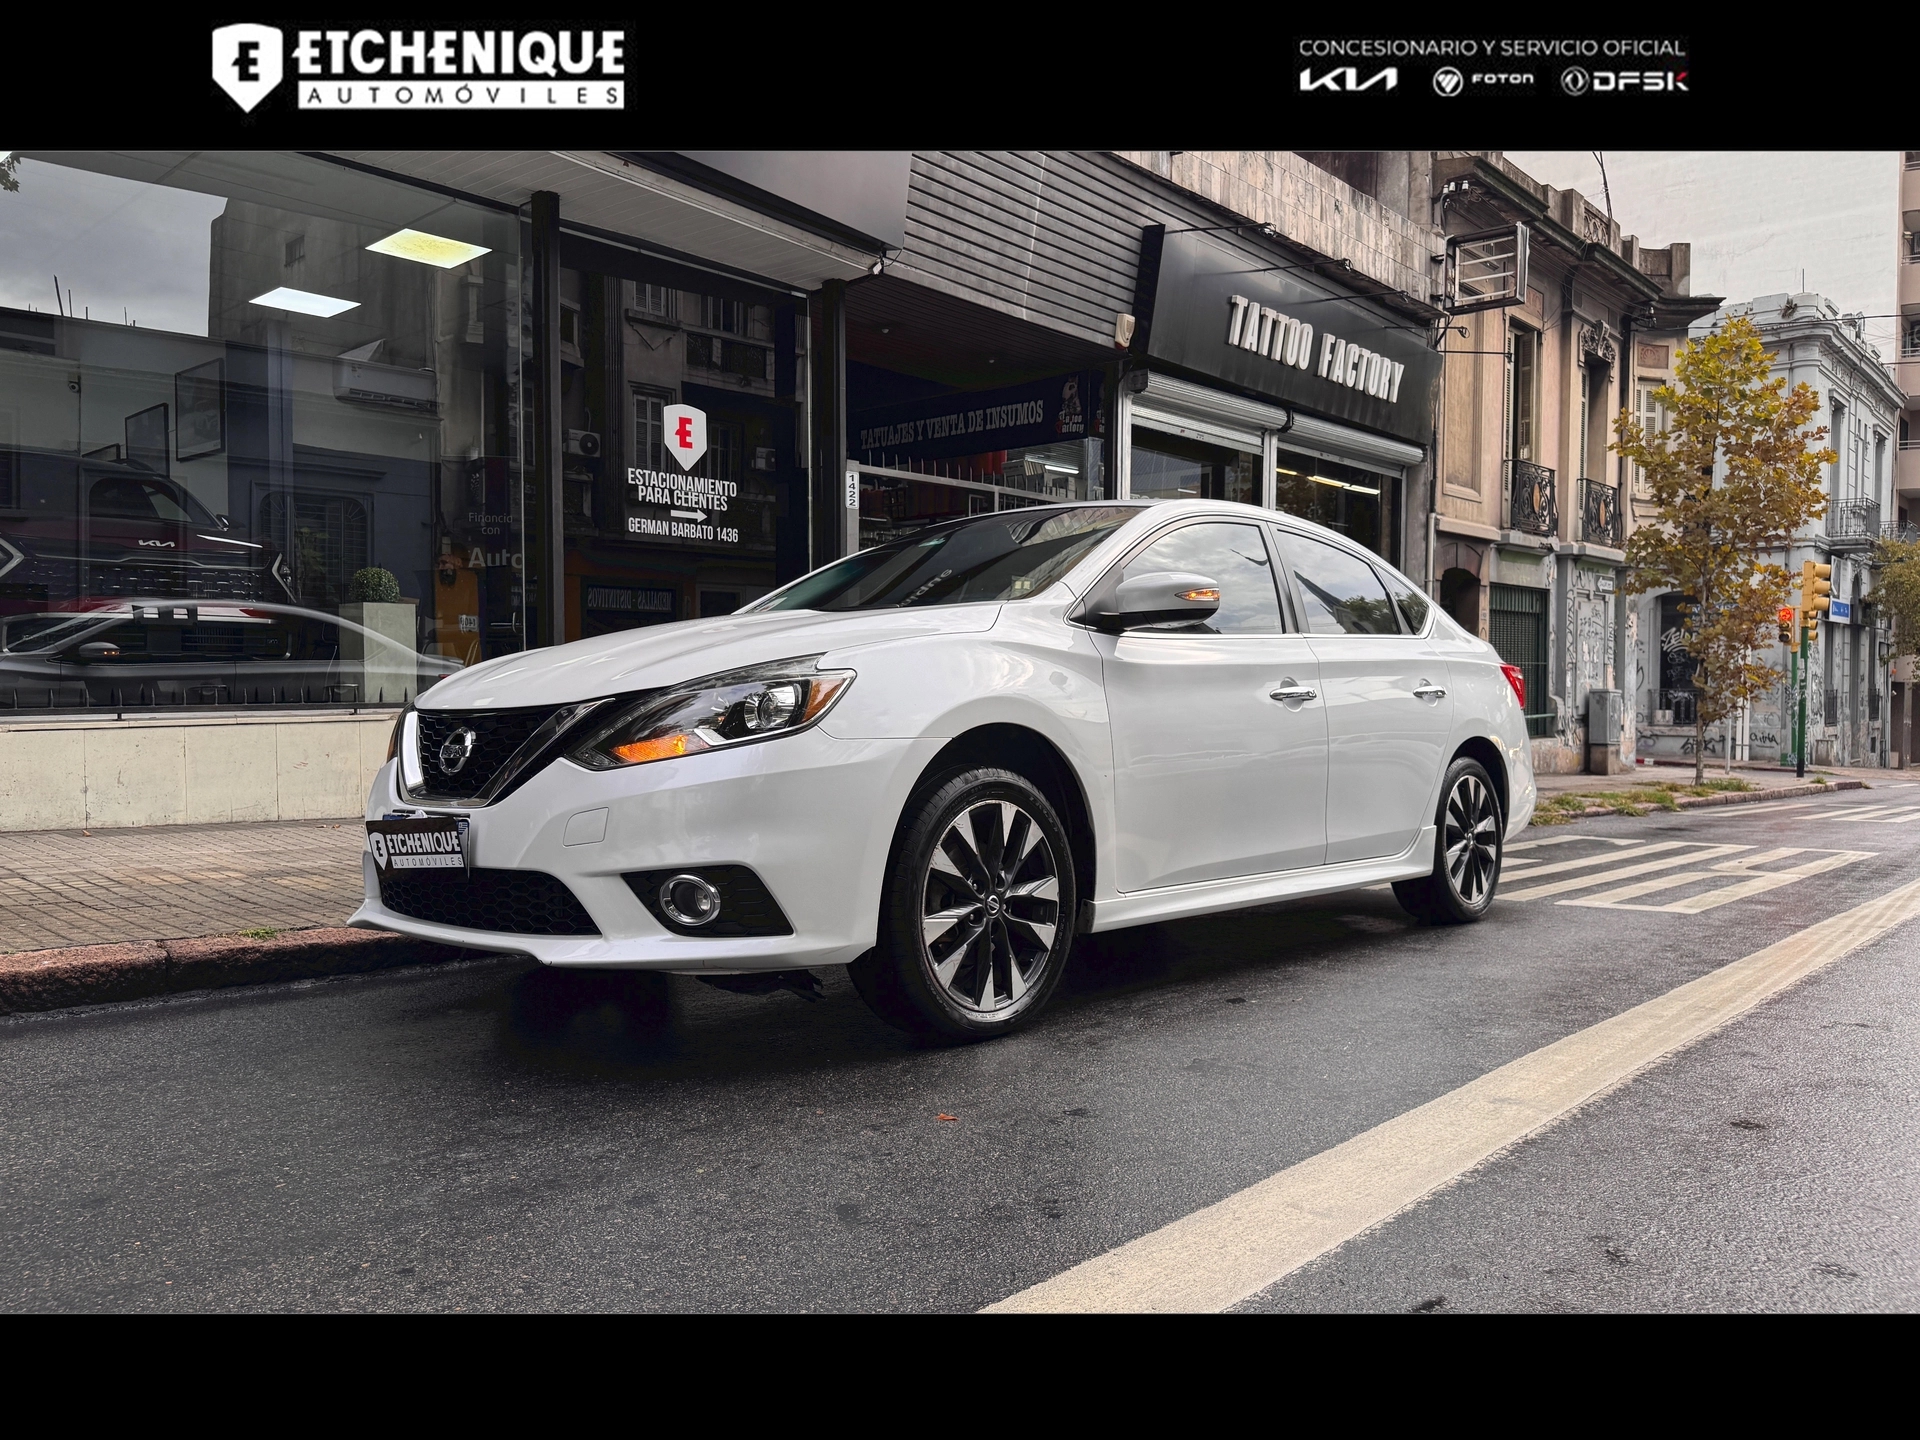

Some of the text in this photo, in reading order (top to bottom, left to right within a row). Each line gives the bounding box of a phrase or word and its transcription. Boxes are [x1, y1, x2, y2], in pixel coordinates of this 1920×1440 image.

[1228, 294, 1405, 403] TATTOO FACTORY
[860, 399, 1044, 449] TATUAJES Y VENTA DE INSUMOS
[627, 467, 737, 497] ESTACIONAMIENTO
[848, 474, 856, 507] 1422
[638, 485, 728, 511] PARA CLIENTES
[468, 512, 513, 524] Financia
[481, 526, 500, 535] con
[628, 517, 739, 543] GERMAN BARBATO 1436
[386, 831, 461, 854] ETCHENIQUE
[393, 855, 464, 867] AUTOMÓVILES
